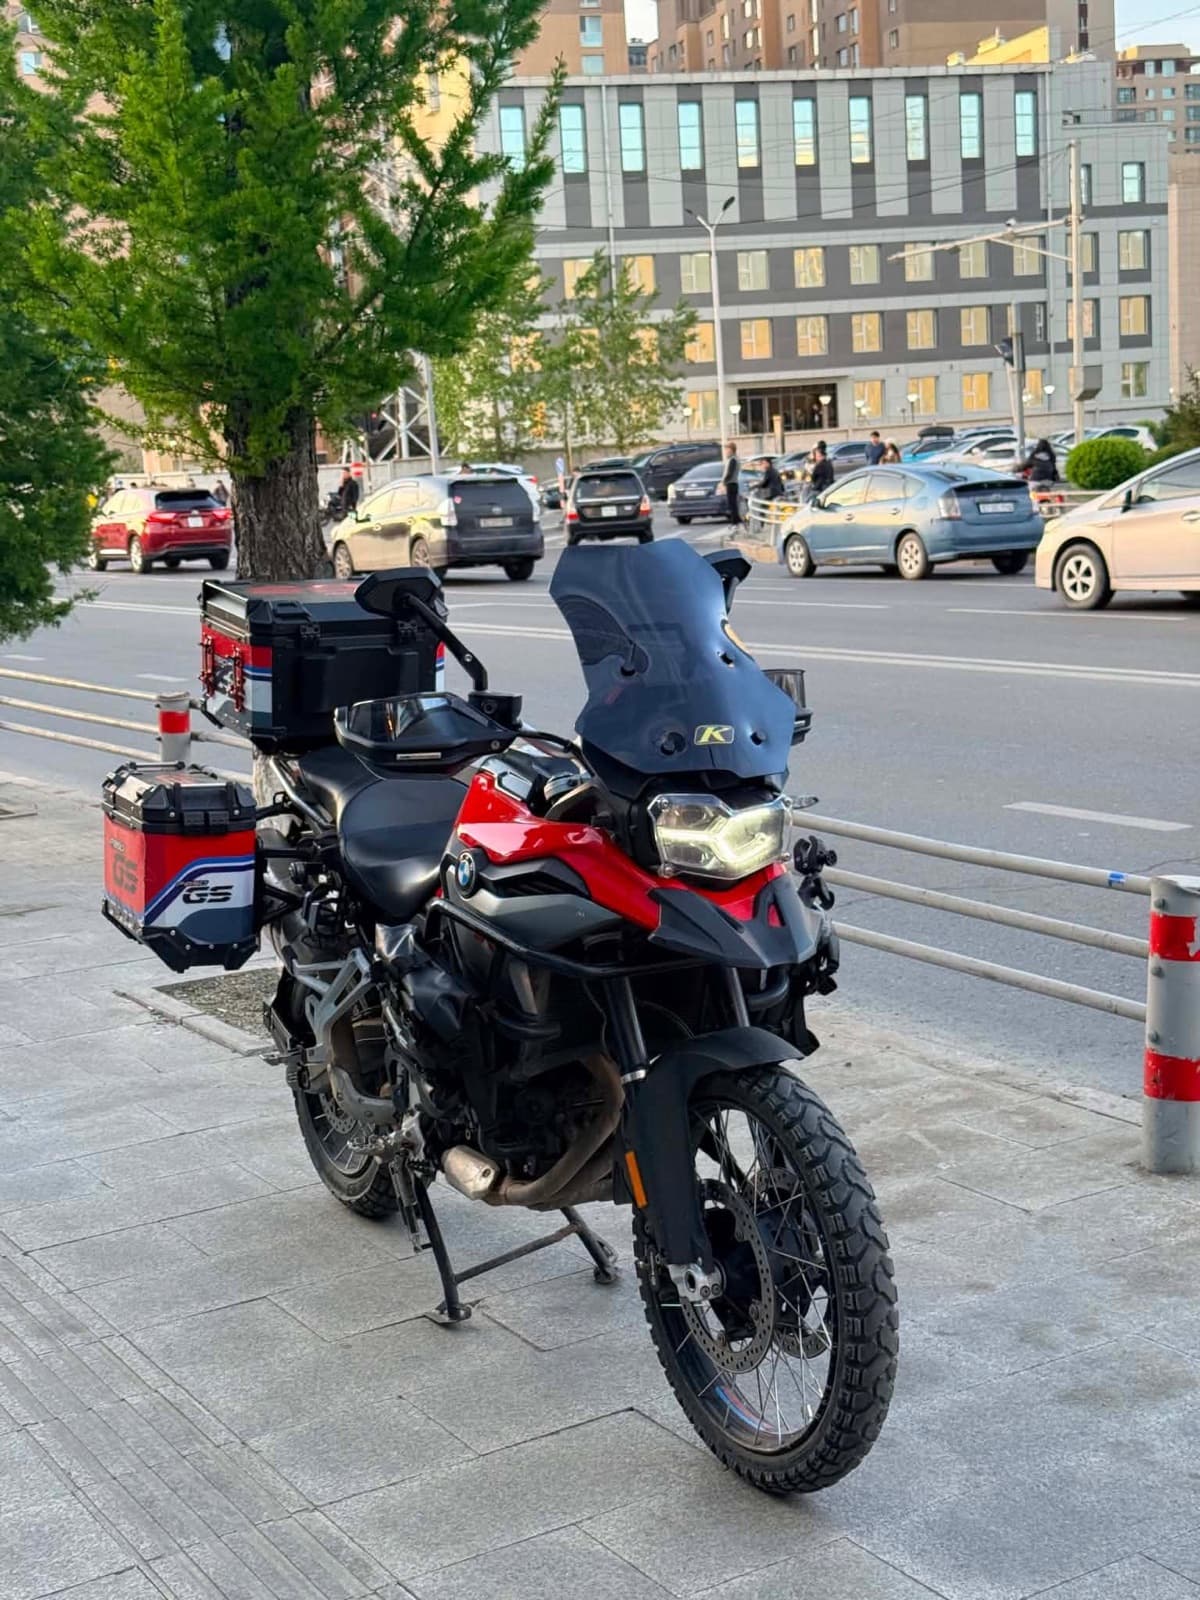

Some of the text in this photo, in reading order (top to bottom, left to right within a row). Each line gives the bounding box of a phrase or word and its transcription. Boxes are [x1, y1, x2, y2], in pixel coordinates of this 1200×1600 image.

[699, 726, 730, 742] K
[112, 852, 138, 894] GS
[182, 885, 233, 904] GS
